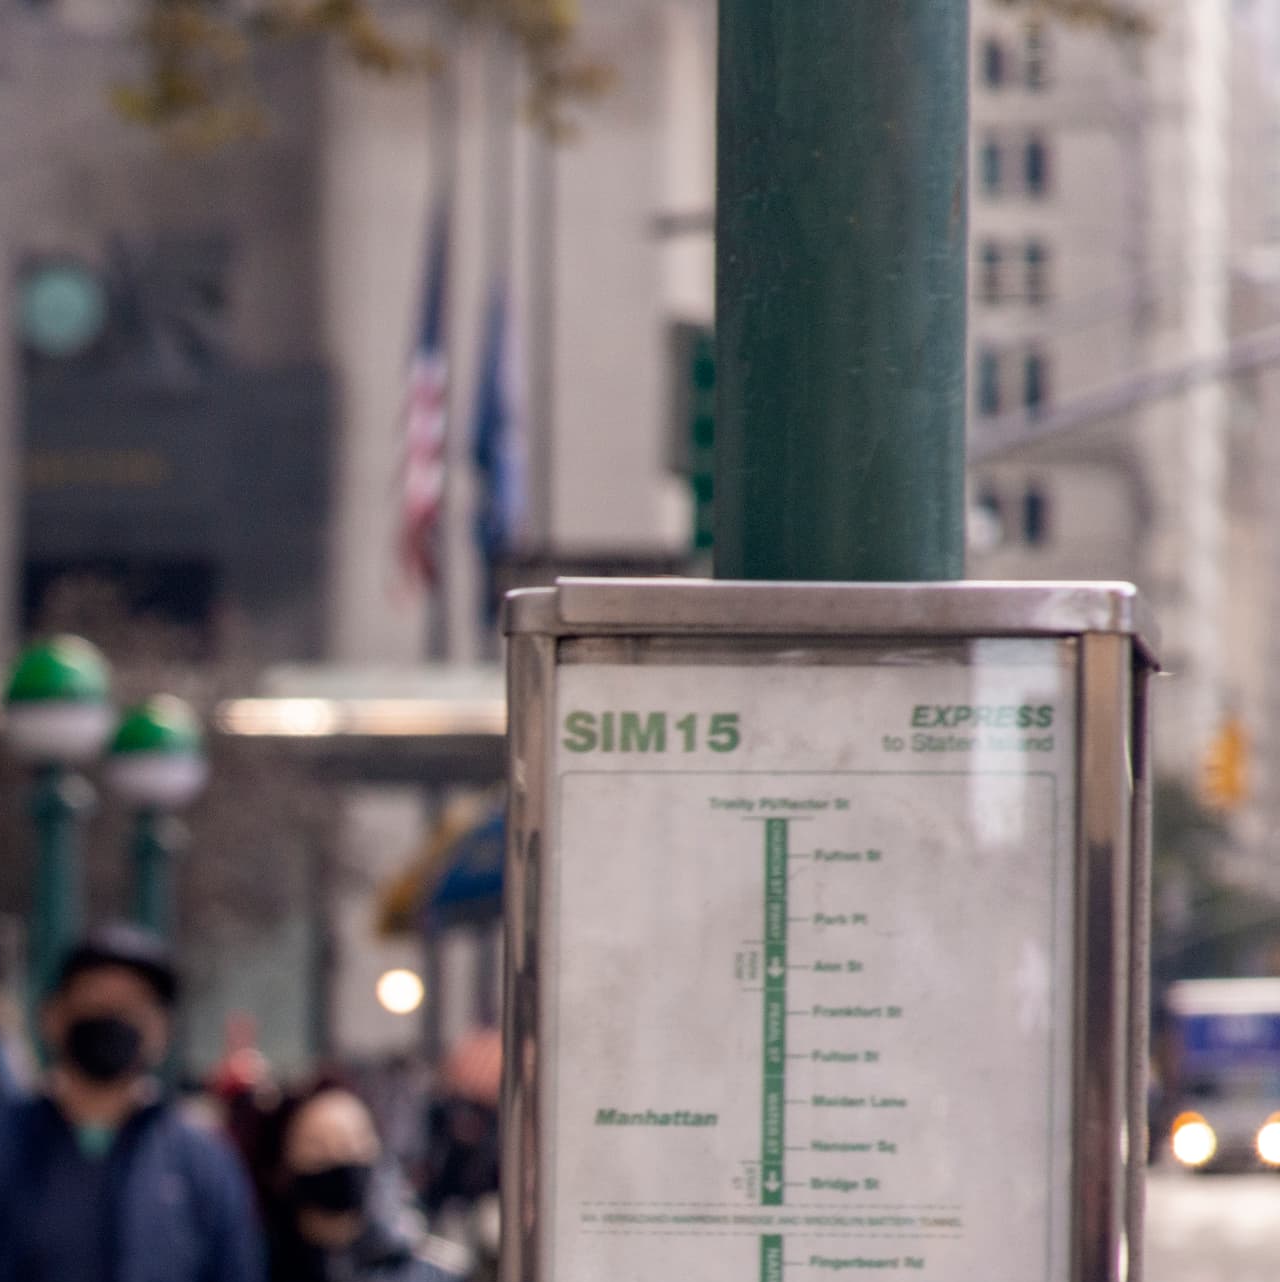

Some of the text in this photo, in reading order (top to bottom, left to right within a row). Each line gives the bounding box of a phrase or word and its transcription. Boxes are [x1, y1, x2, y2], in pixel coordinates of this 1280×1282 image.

[910, 704, 1054, 728] EXPRESS
[563, 710, 741, 753] SIM15
[882, 735, 904, 752] to
[833, 798, 850, 810] St
[813, 848, 882, 863] Fulton St
[813, 912, 848, 926] Park
[812, 960, 863, 973] Ann St
[812, 1005, 902, 1018] Frankfort St
[810, 1049, 880, 1063] Fulton St
[811, 1094, 907, 1108] Maiden Lane
[595, 1108, 718, 1127] Manhattan
[810, 1139, 896, 1154] Hanover Sq
[810, 1178, 880, 1193] Bridge St
[809, 1255, 924, 1271] Fingerboard Rd
